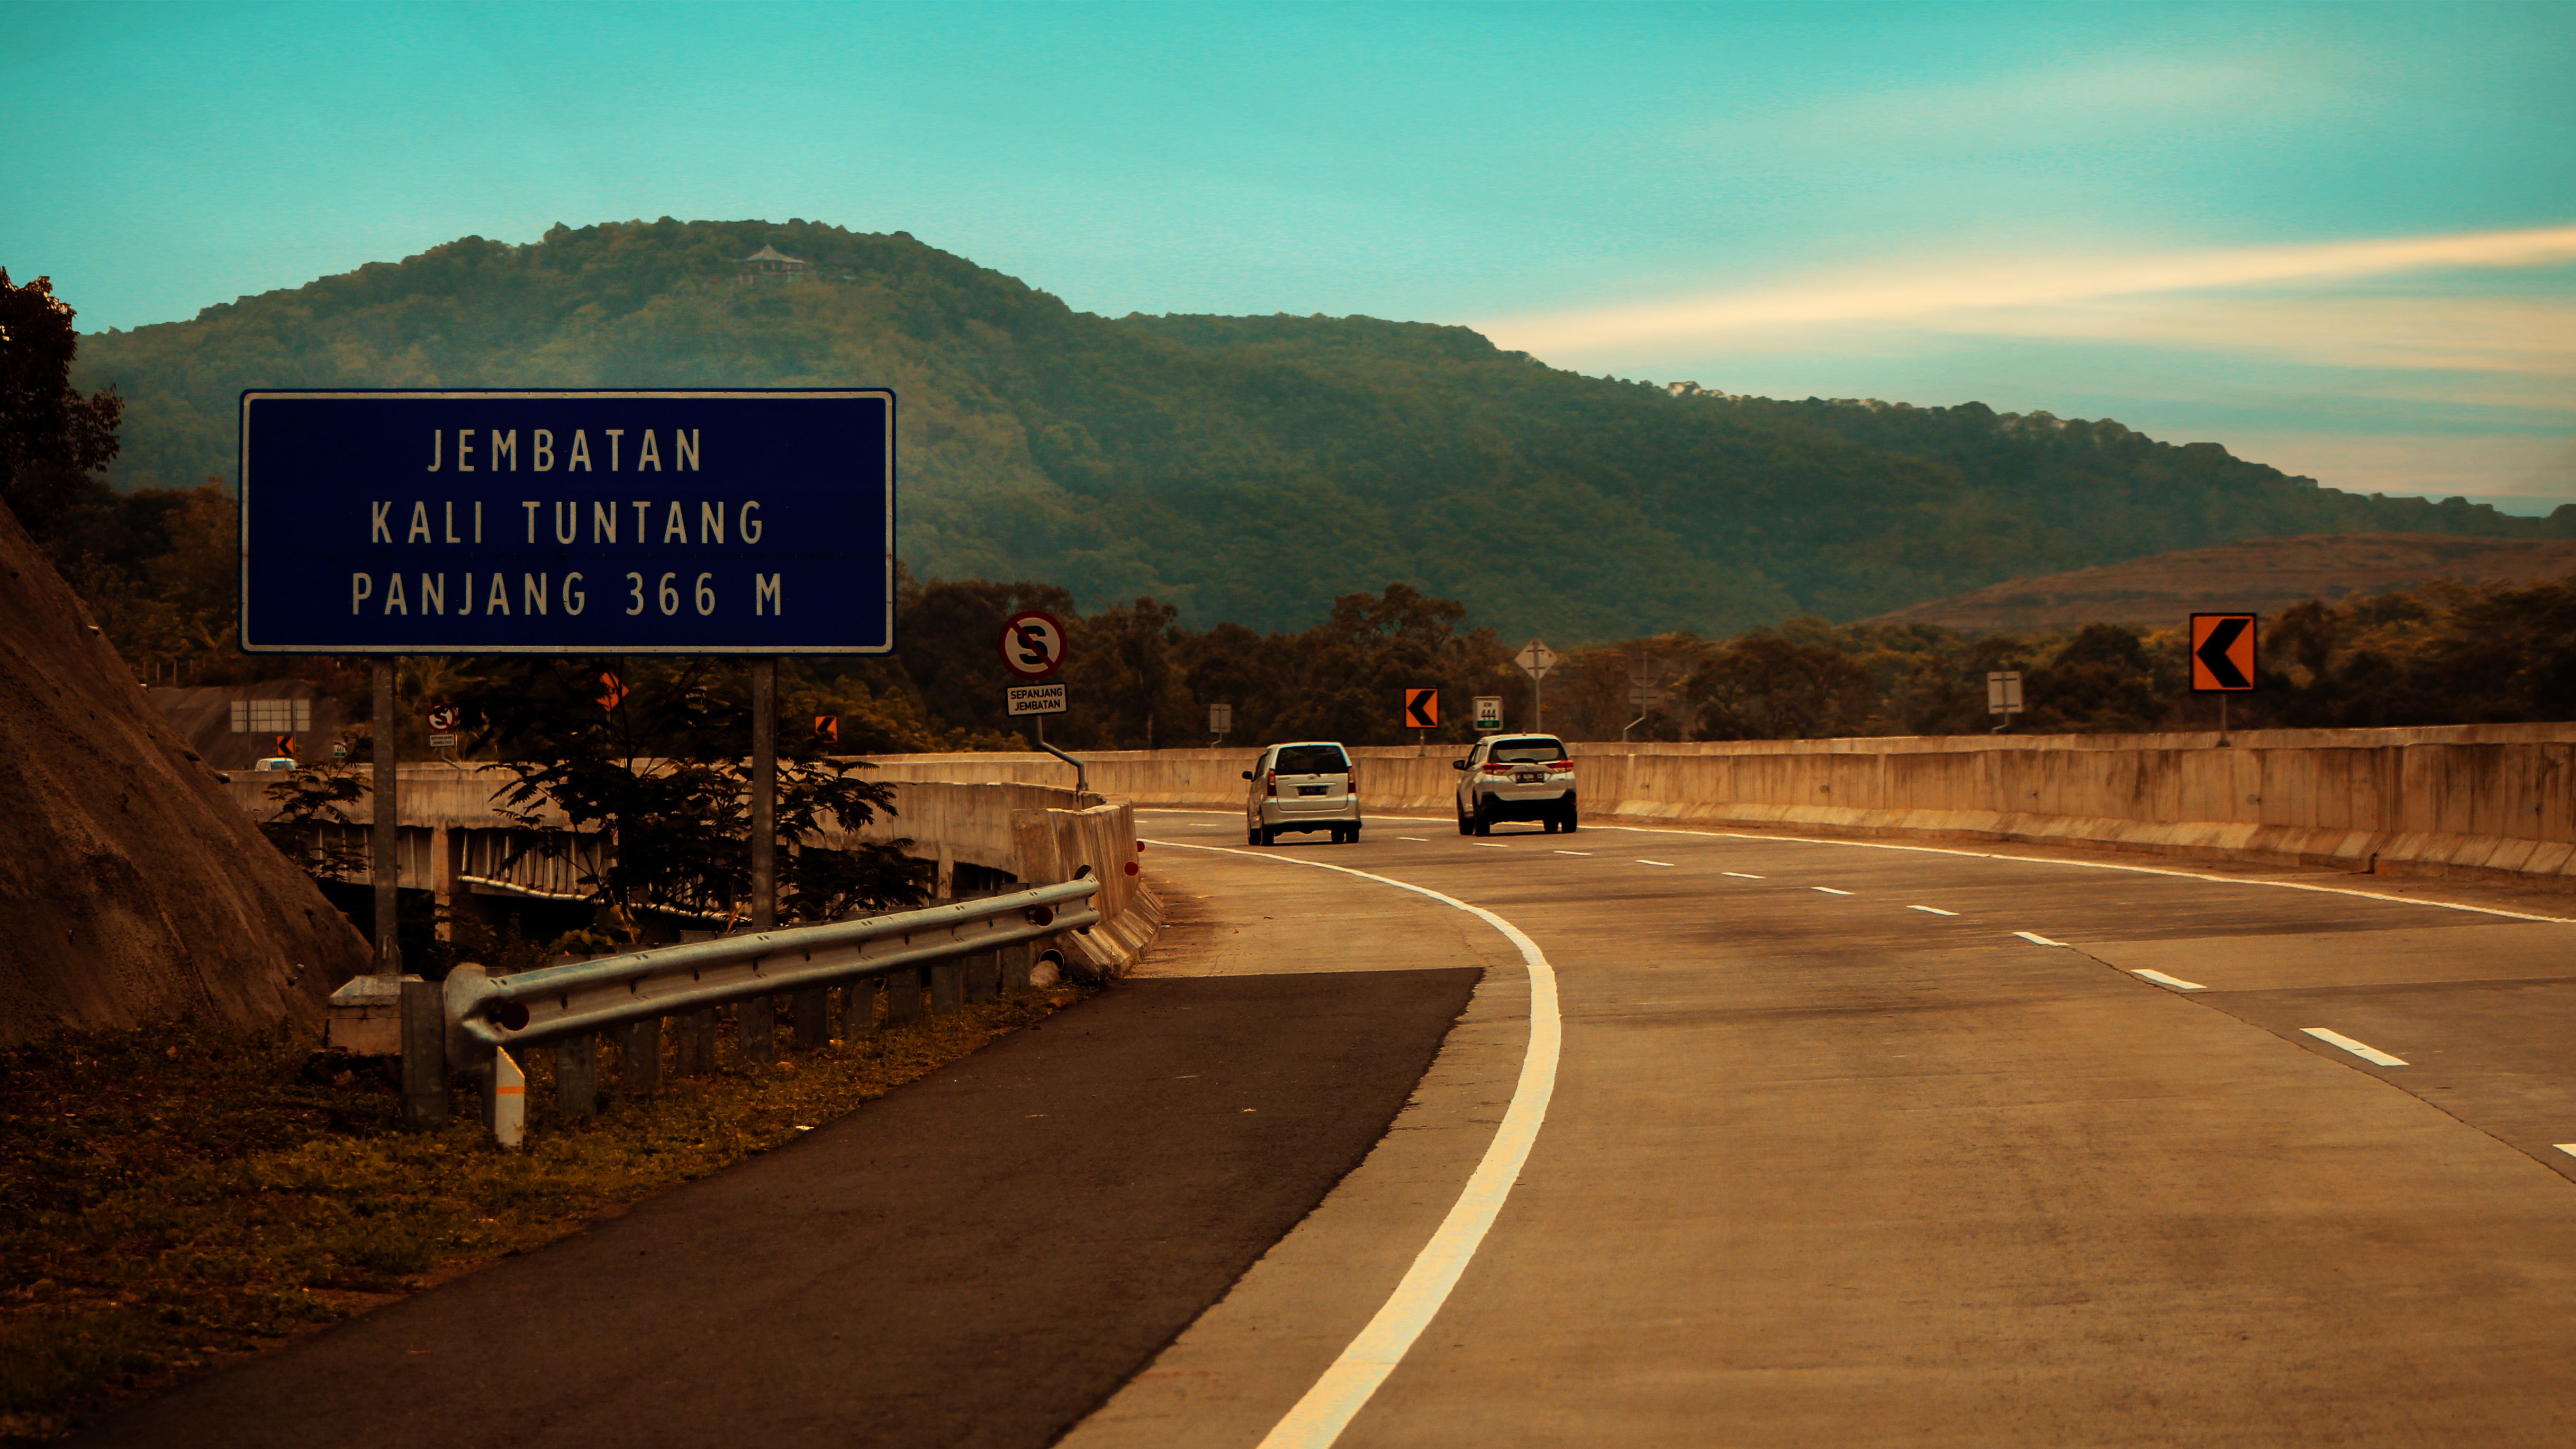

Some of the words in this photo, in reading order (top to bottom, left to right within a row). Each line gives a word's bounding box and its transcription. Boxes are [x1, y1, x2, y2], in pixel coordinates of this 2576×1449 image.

[427, 429, 700, 472] JEMBATAN
[372, 501, 482, 544] KALI
[522, 500, 763, 545] TUNTANG
[353, 572, 585, 616] PANJANG
[626, 572, 716, 616] 366
[756, 573, 782, 616] M
[1010, 688, 1063, 700] SEPANJANG
[1015, 700, 1061, 711] JEMBATAN
